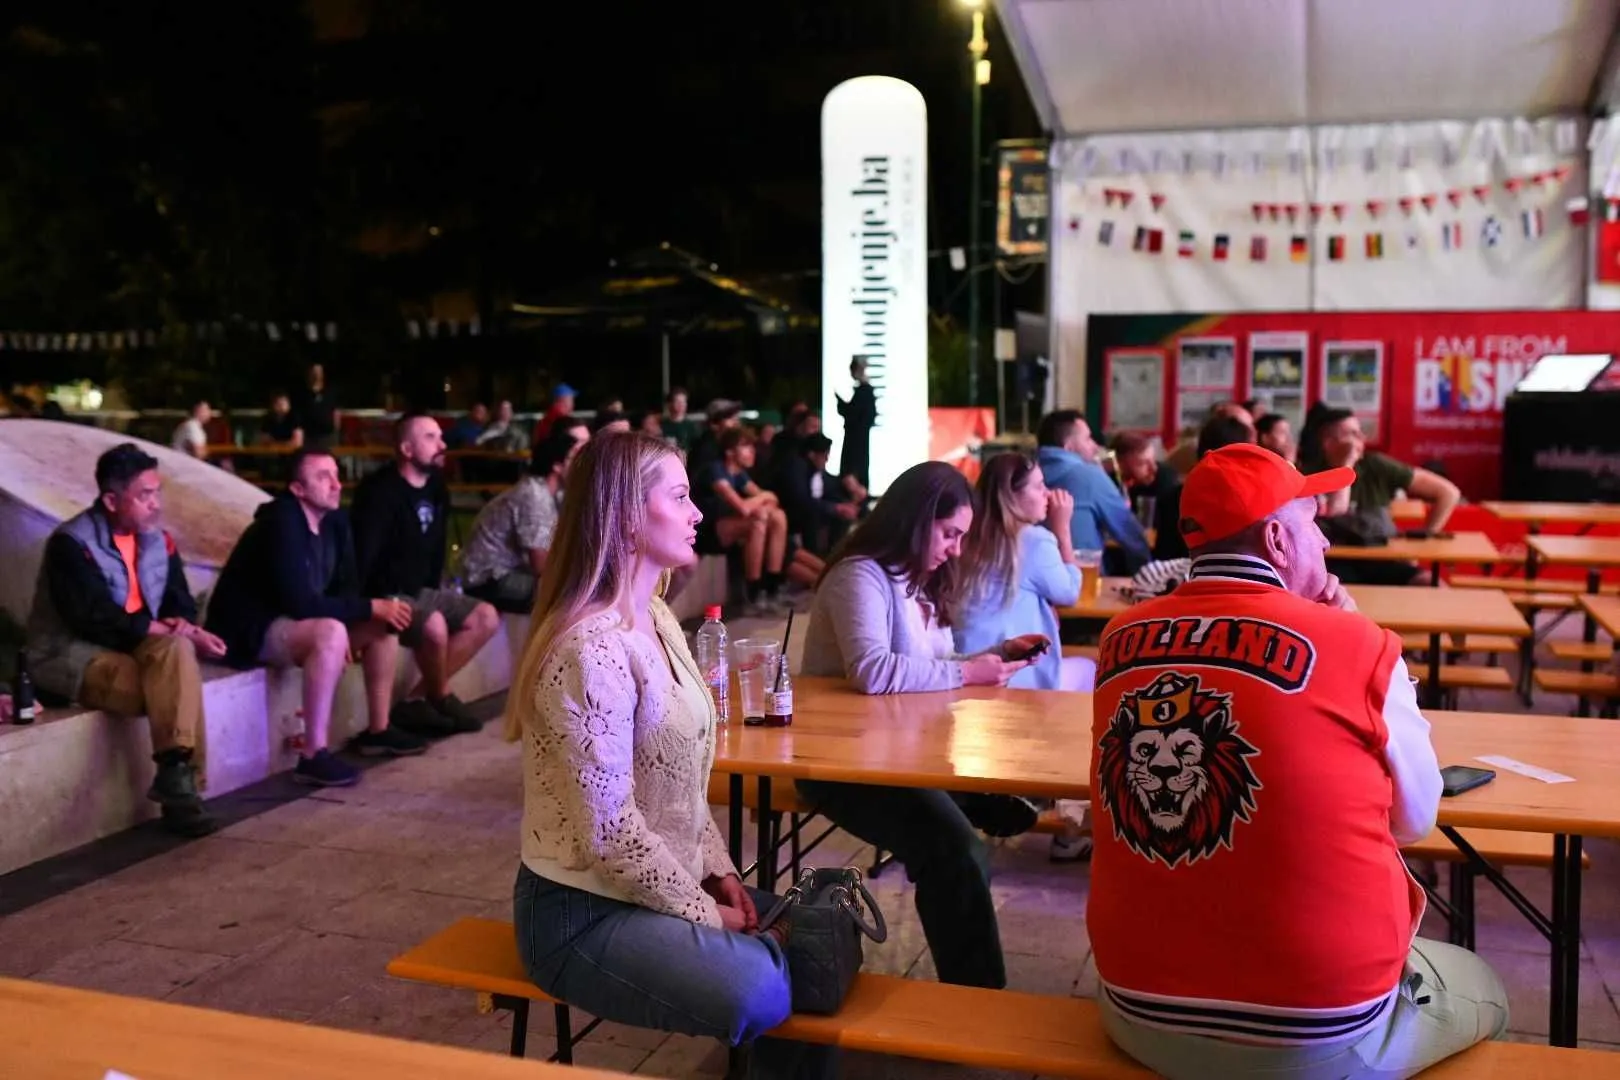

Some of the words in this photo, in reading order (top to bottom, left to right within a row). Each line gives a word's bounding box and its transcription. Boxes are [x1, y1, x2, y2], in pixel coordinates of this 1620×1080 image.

[1430, 335, 1477, 358] AM
[1483, 335, 1568, 359] FROM
[1097, 617, 1311, 684] HOLLAND
